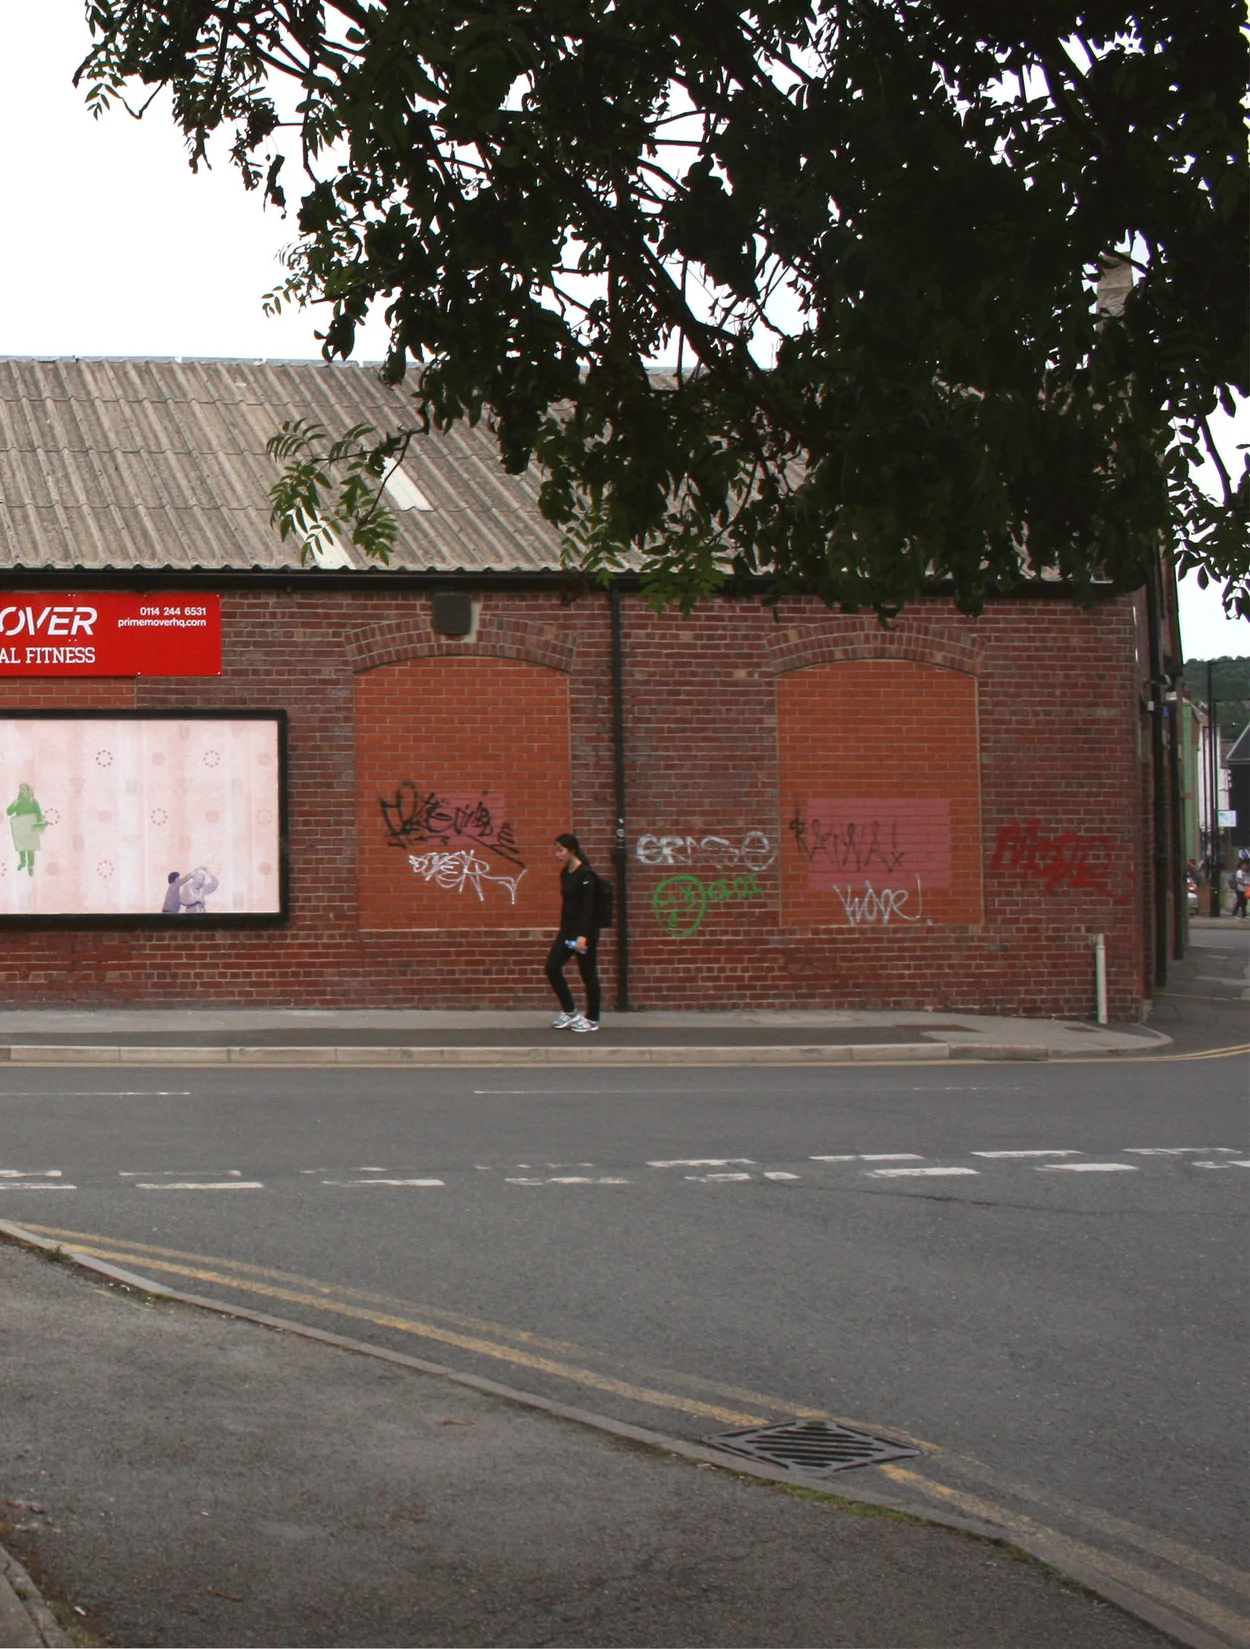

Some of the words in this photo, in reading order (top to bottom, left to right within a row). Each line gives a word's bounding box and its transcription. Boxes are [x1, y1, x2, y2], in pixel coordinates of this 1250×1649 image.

[139, 606, 161, 616] 0114
[163, 606, 182, 616] 244
[184, 606, 207, 616] 6531
[117, 617, 207, 628] primemoverhq.com
[25, 646, 96, 664] FITNESS
